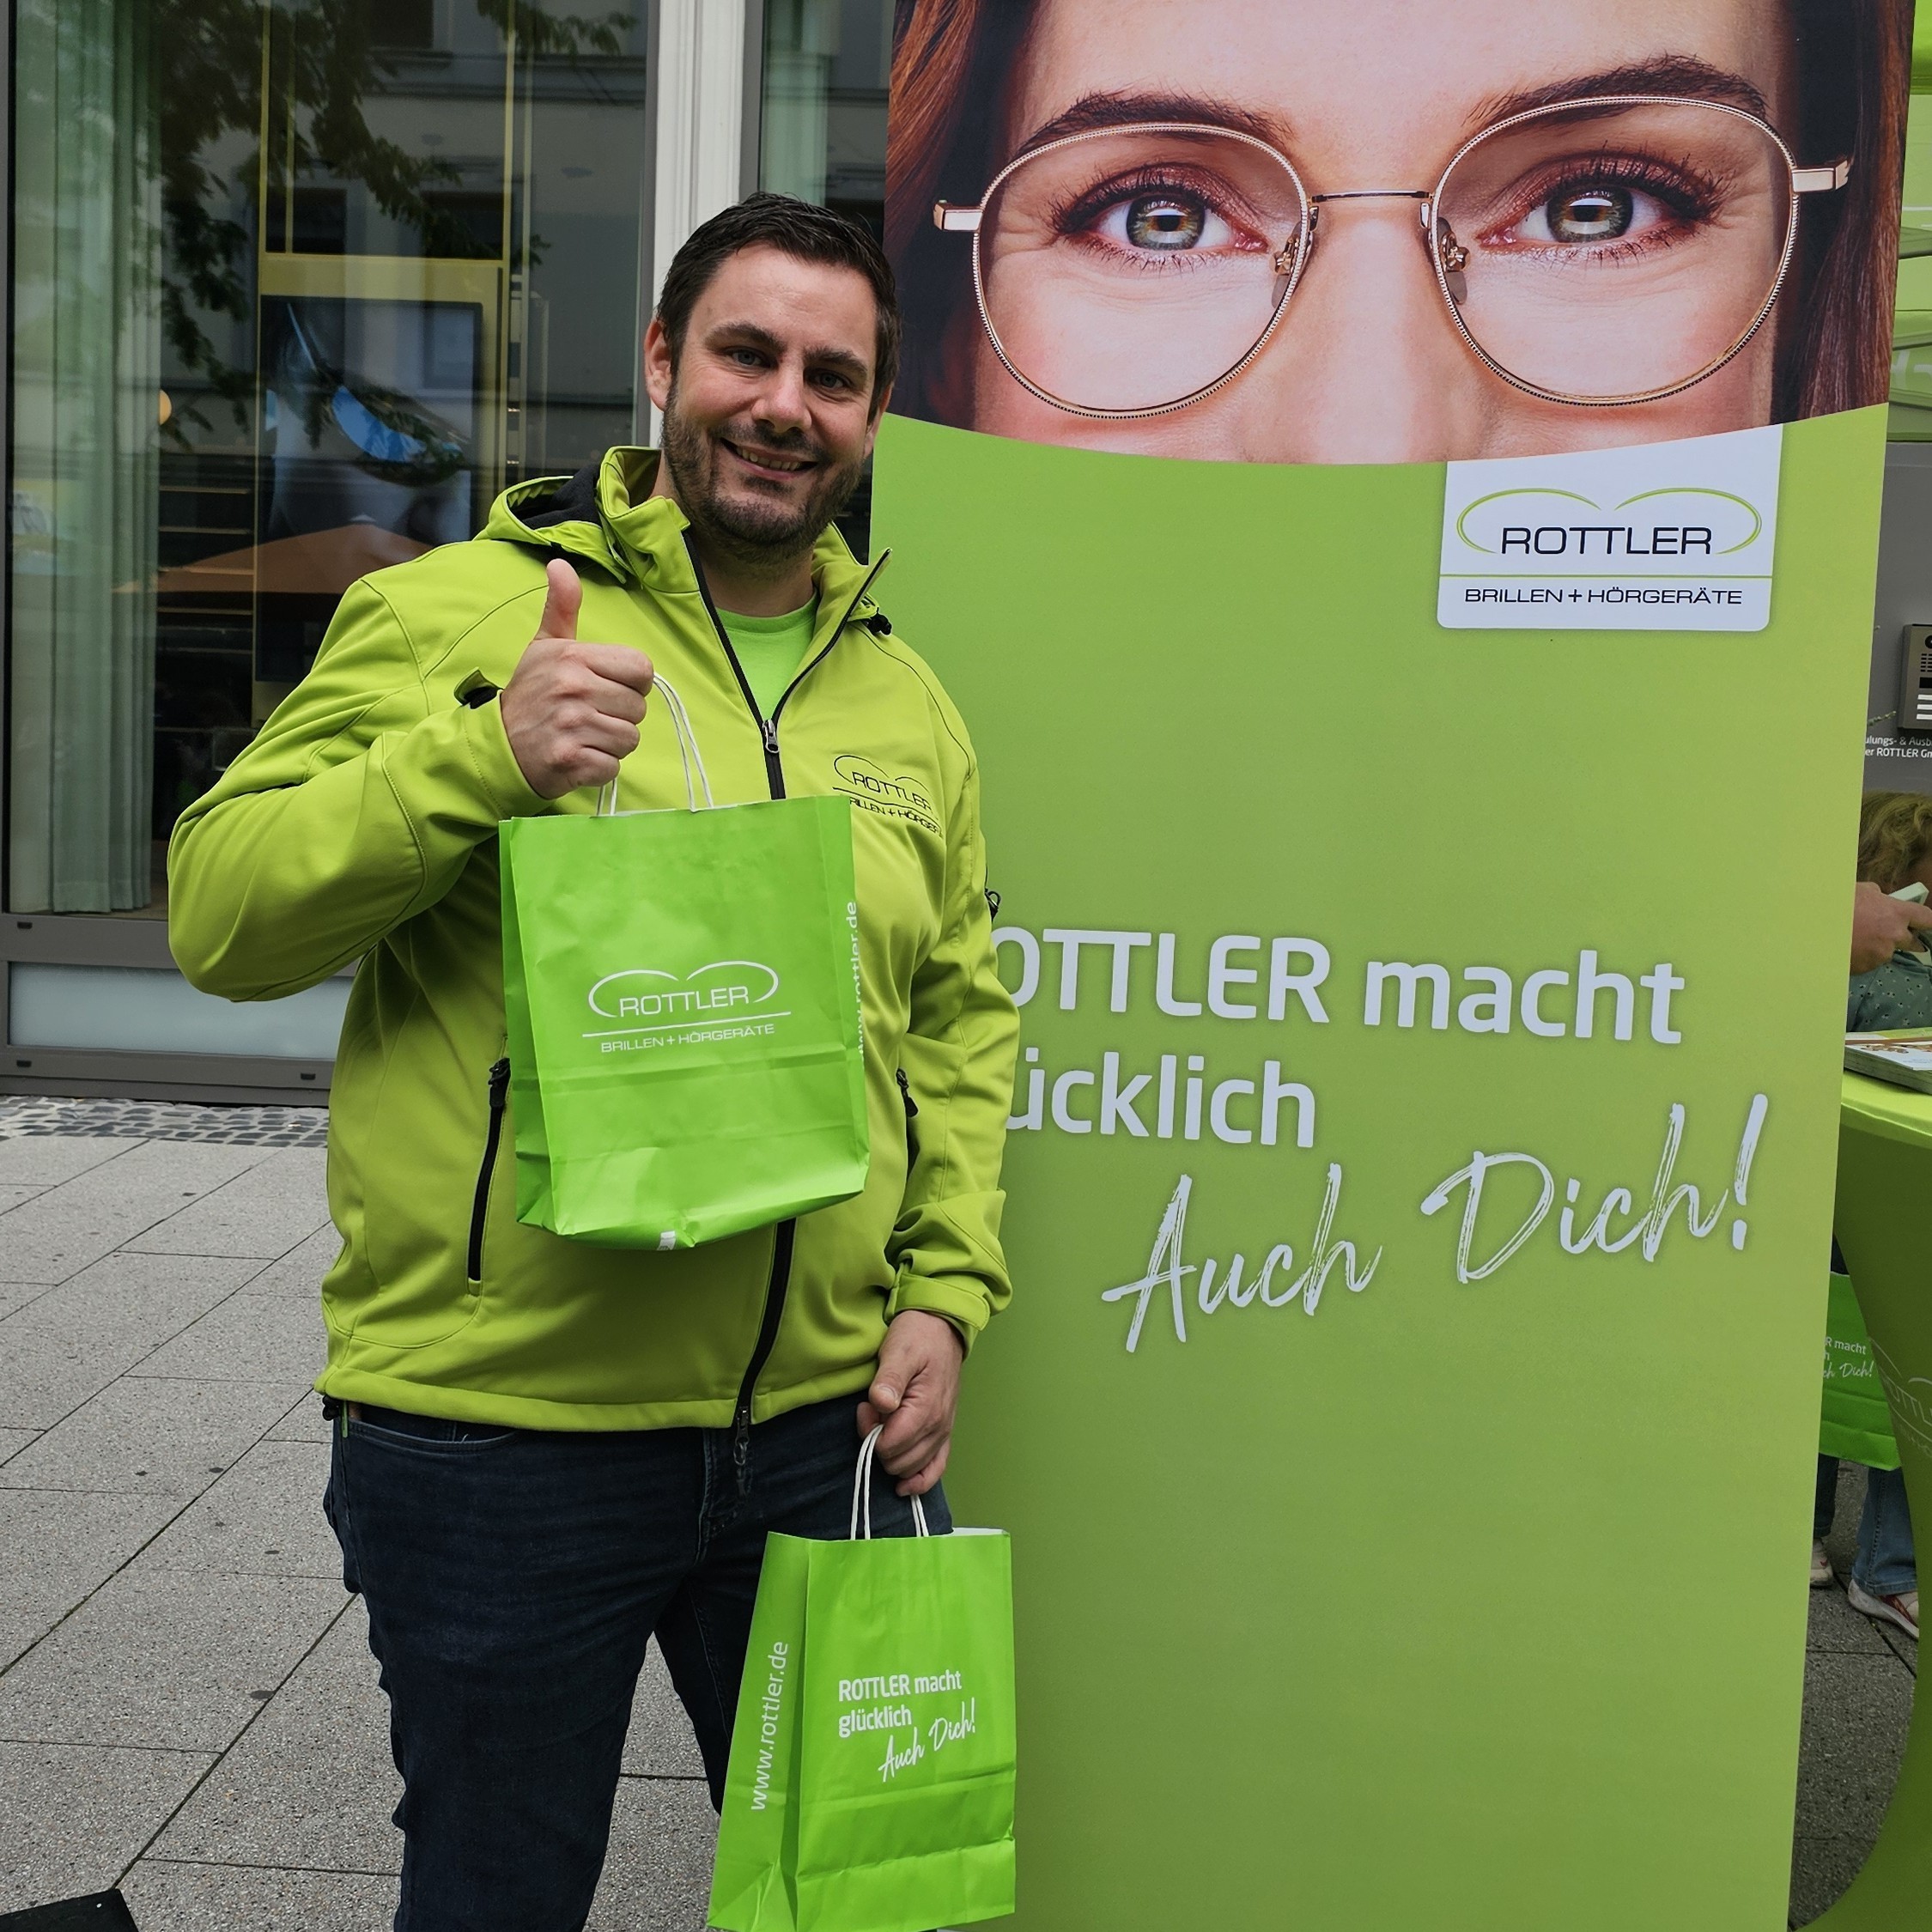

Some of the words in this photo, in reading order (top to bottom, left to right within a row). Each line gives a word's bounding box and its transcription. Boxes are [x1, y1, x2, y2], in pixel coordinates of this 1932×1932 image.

[1501, 526, 1712, 555] ROTTLER
[1464, 588, 1564, 603] BRILLEN
[1588, 586, 1743, 605] HÖRGERÄTE
[1876, 747, 1918, 758] ROTTLER
[1899, 737, 1906, 745] &
[1908, 737, 1932, 746] Ausb
[849, 797, 886, 815] RILLEN
[852, 771, 933, 814] ROTTLER
[990, 927, 1330, 1024] OTTLER
[1364, 949, 1686, 1044] macht
[619, 986, 750, 1018] ROTTLER
[601, 1036, 664, 1054] BRILLEN
[678, 1023, 775, 1046] HÖRGERÄTE
[1101, 1162, 1382, 1353] Auch
[1421, 1093, 1769, 1285] Dich!
[1834, 1340, 1866, 1355] macht
[1838, 1360, 1874, 1377] Dich!
[838, 1674, 911, 1703] ROTTLER
[914, 1669, 963, 1695] macht
[750, 1641, 789, 1812] www.rottler.de
[838, 1704, 913, 1739] glücklich
[878, 1727, 926, 1783] Auch
[928, 1697, 976, 1752] Dich!
